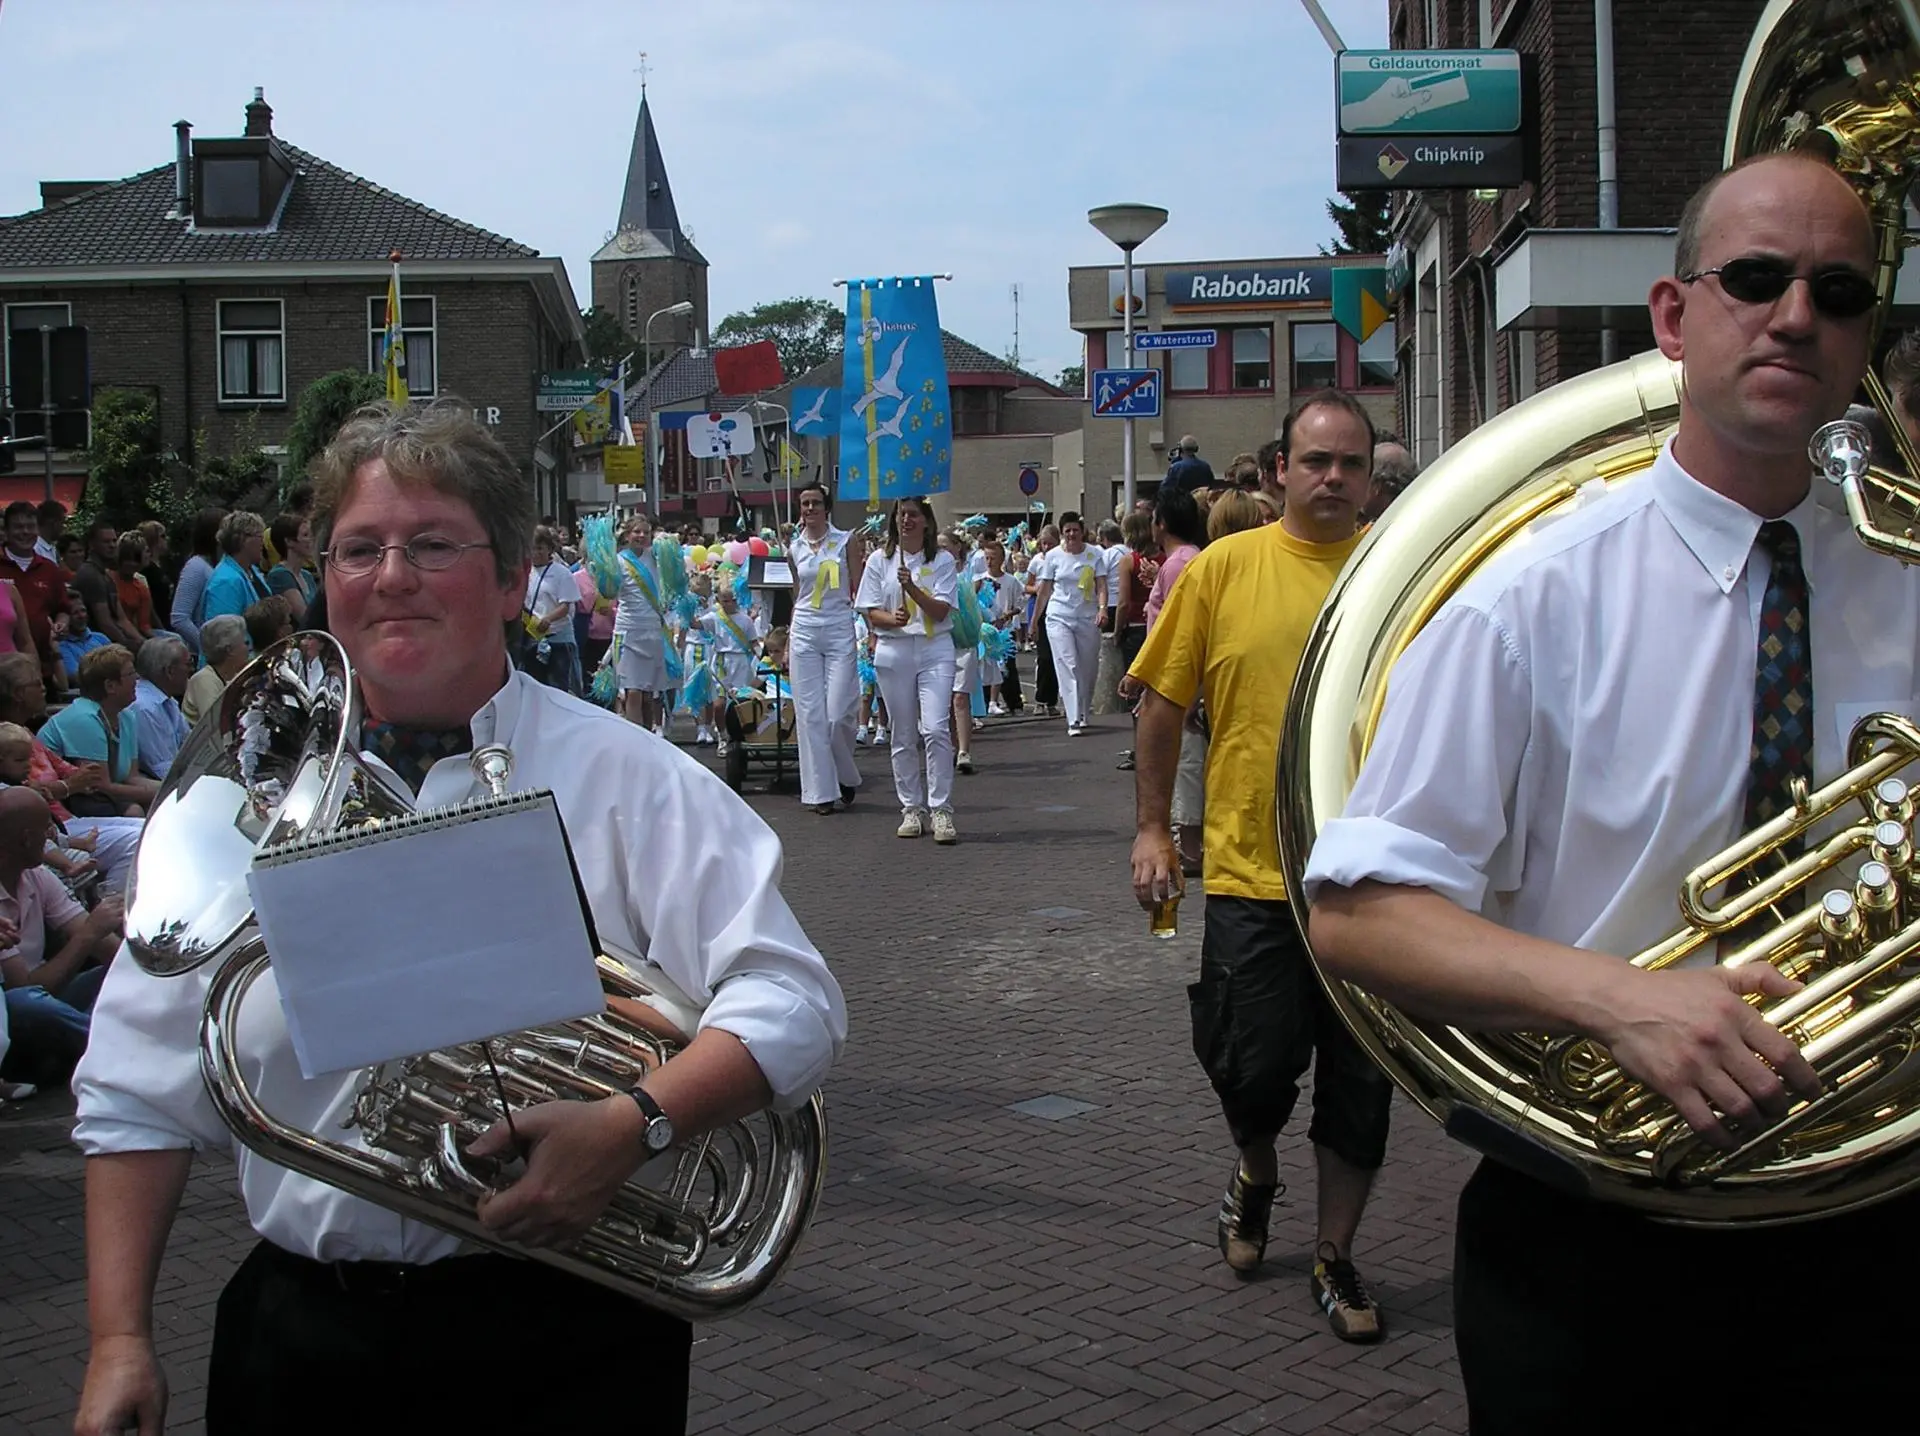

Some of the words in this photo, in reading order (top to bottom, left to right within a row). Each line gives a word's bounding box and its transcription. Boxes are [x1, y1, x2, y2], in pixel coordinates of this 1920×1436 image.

[1368, 56, 1482, 70] Geldautomaat
[1414, 146, 1485, 165] Chipknip
[1191, 271, 1311, 299] Rabobank
[1152, 333, 1212, 346] Waterstraat
[551, 378, 591, 388] Vaillant
